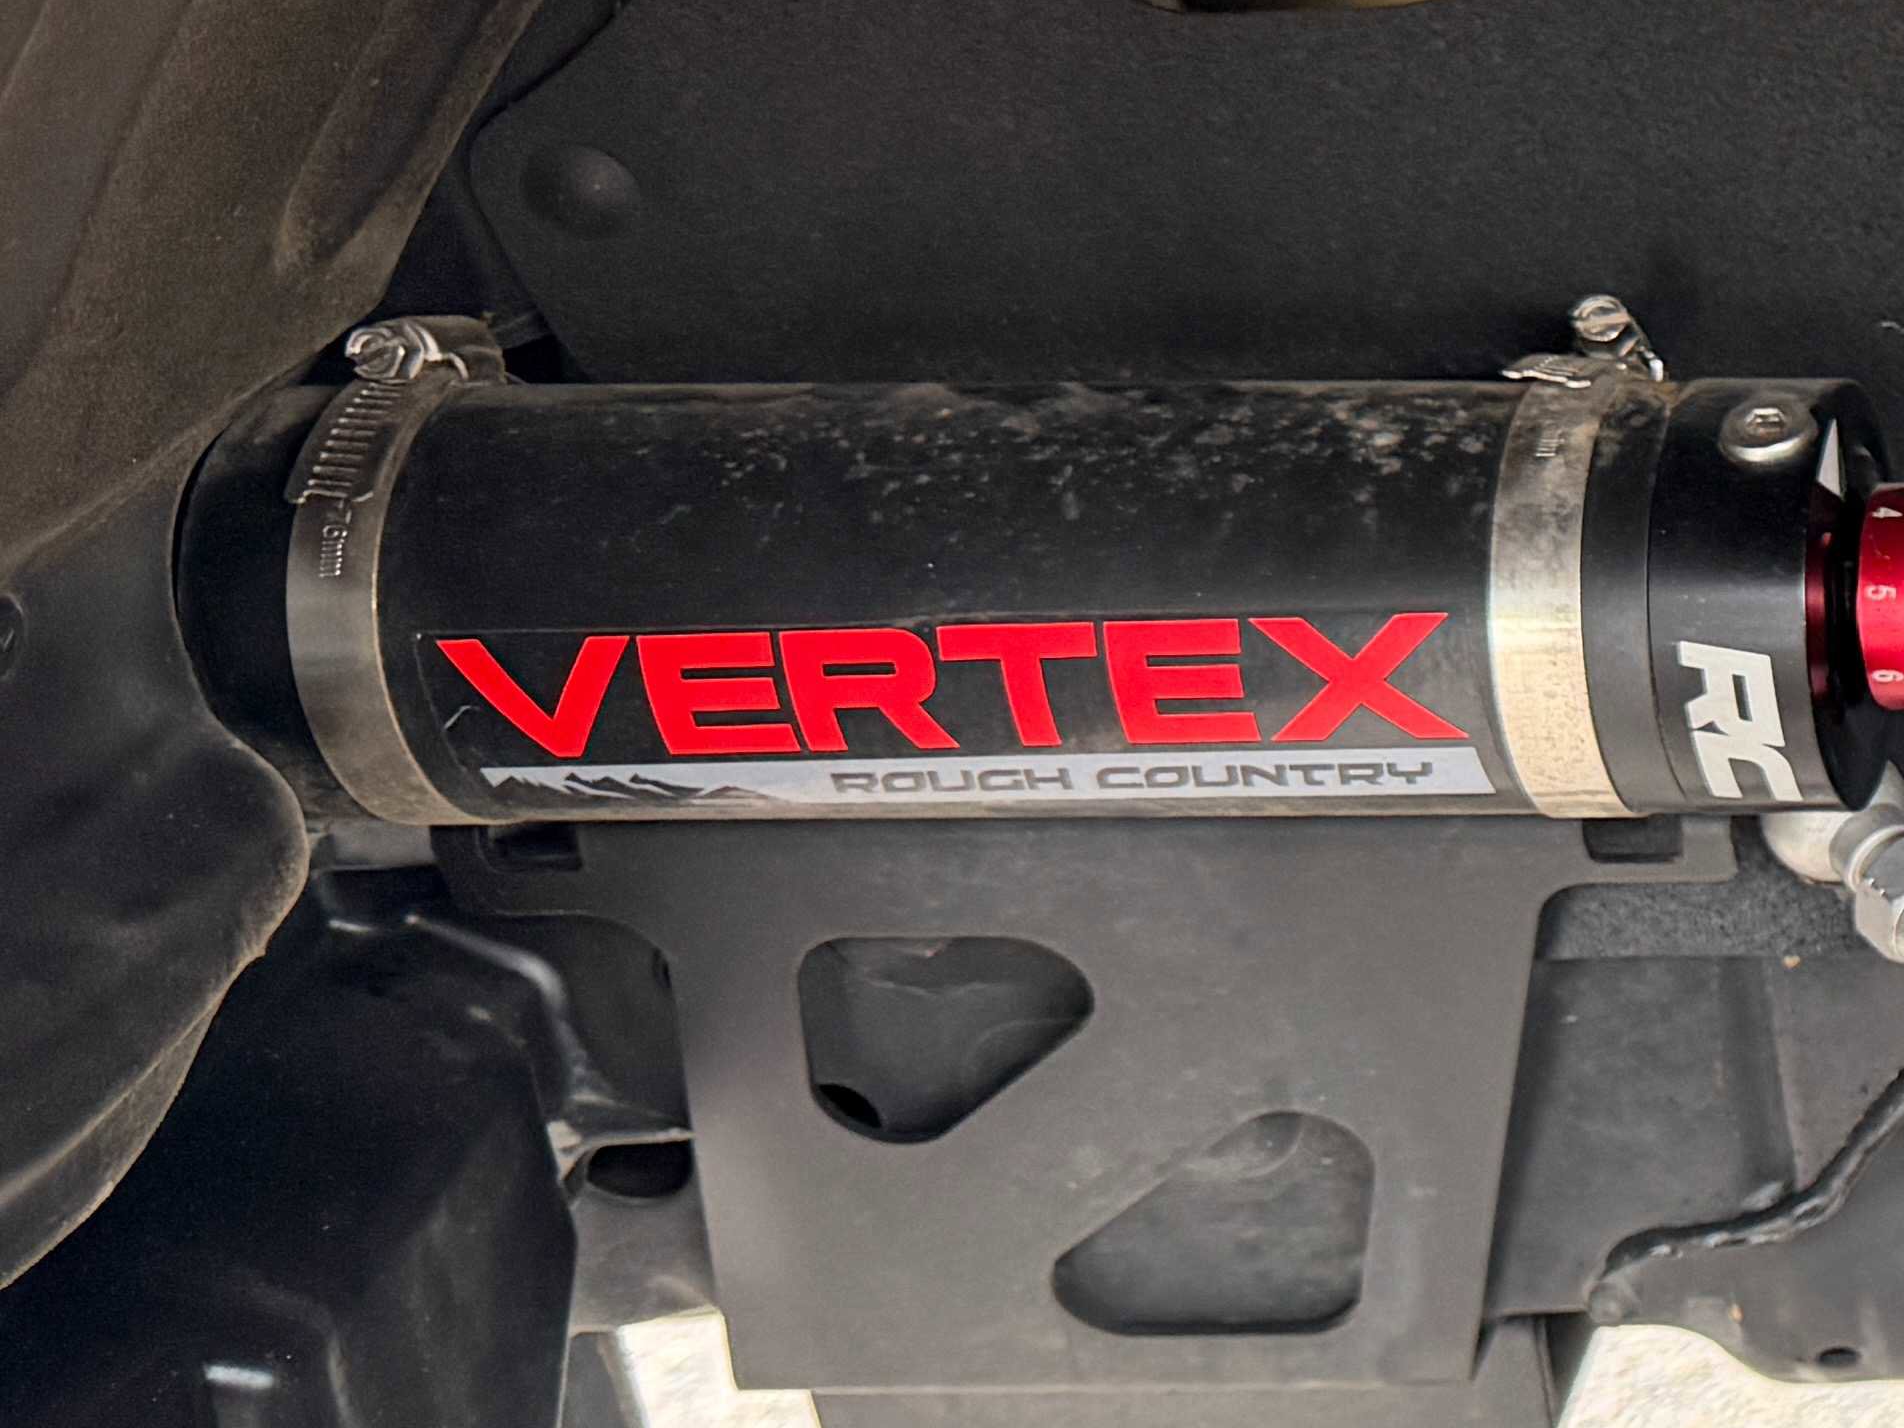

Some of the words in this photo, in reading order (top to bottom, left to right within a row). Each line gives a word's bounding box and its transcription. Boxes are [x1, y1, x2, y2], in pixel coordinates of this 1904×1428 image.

[1864, 584, 1897, 601] 5
[436, 612, 1469, 759] VERTEX
[1871, 669, 1904, 683] 6
[1677, 640, 1804, 802] RC
[829, 767, 1072, 795] ROUGH
[1096, 760, 1434, 790] COUNTRY
